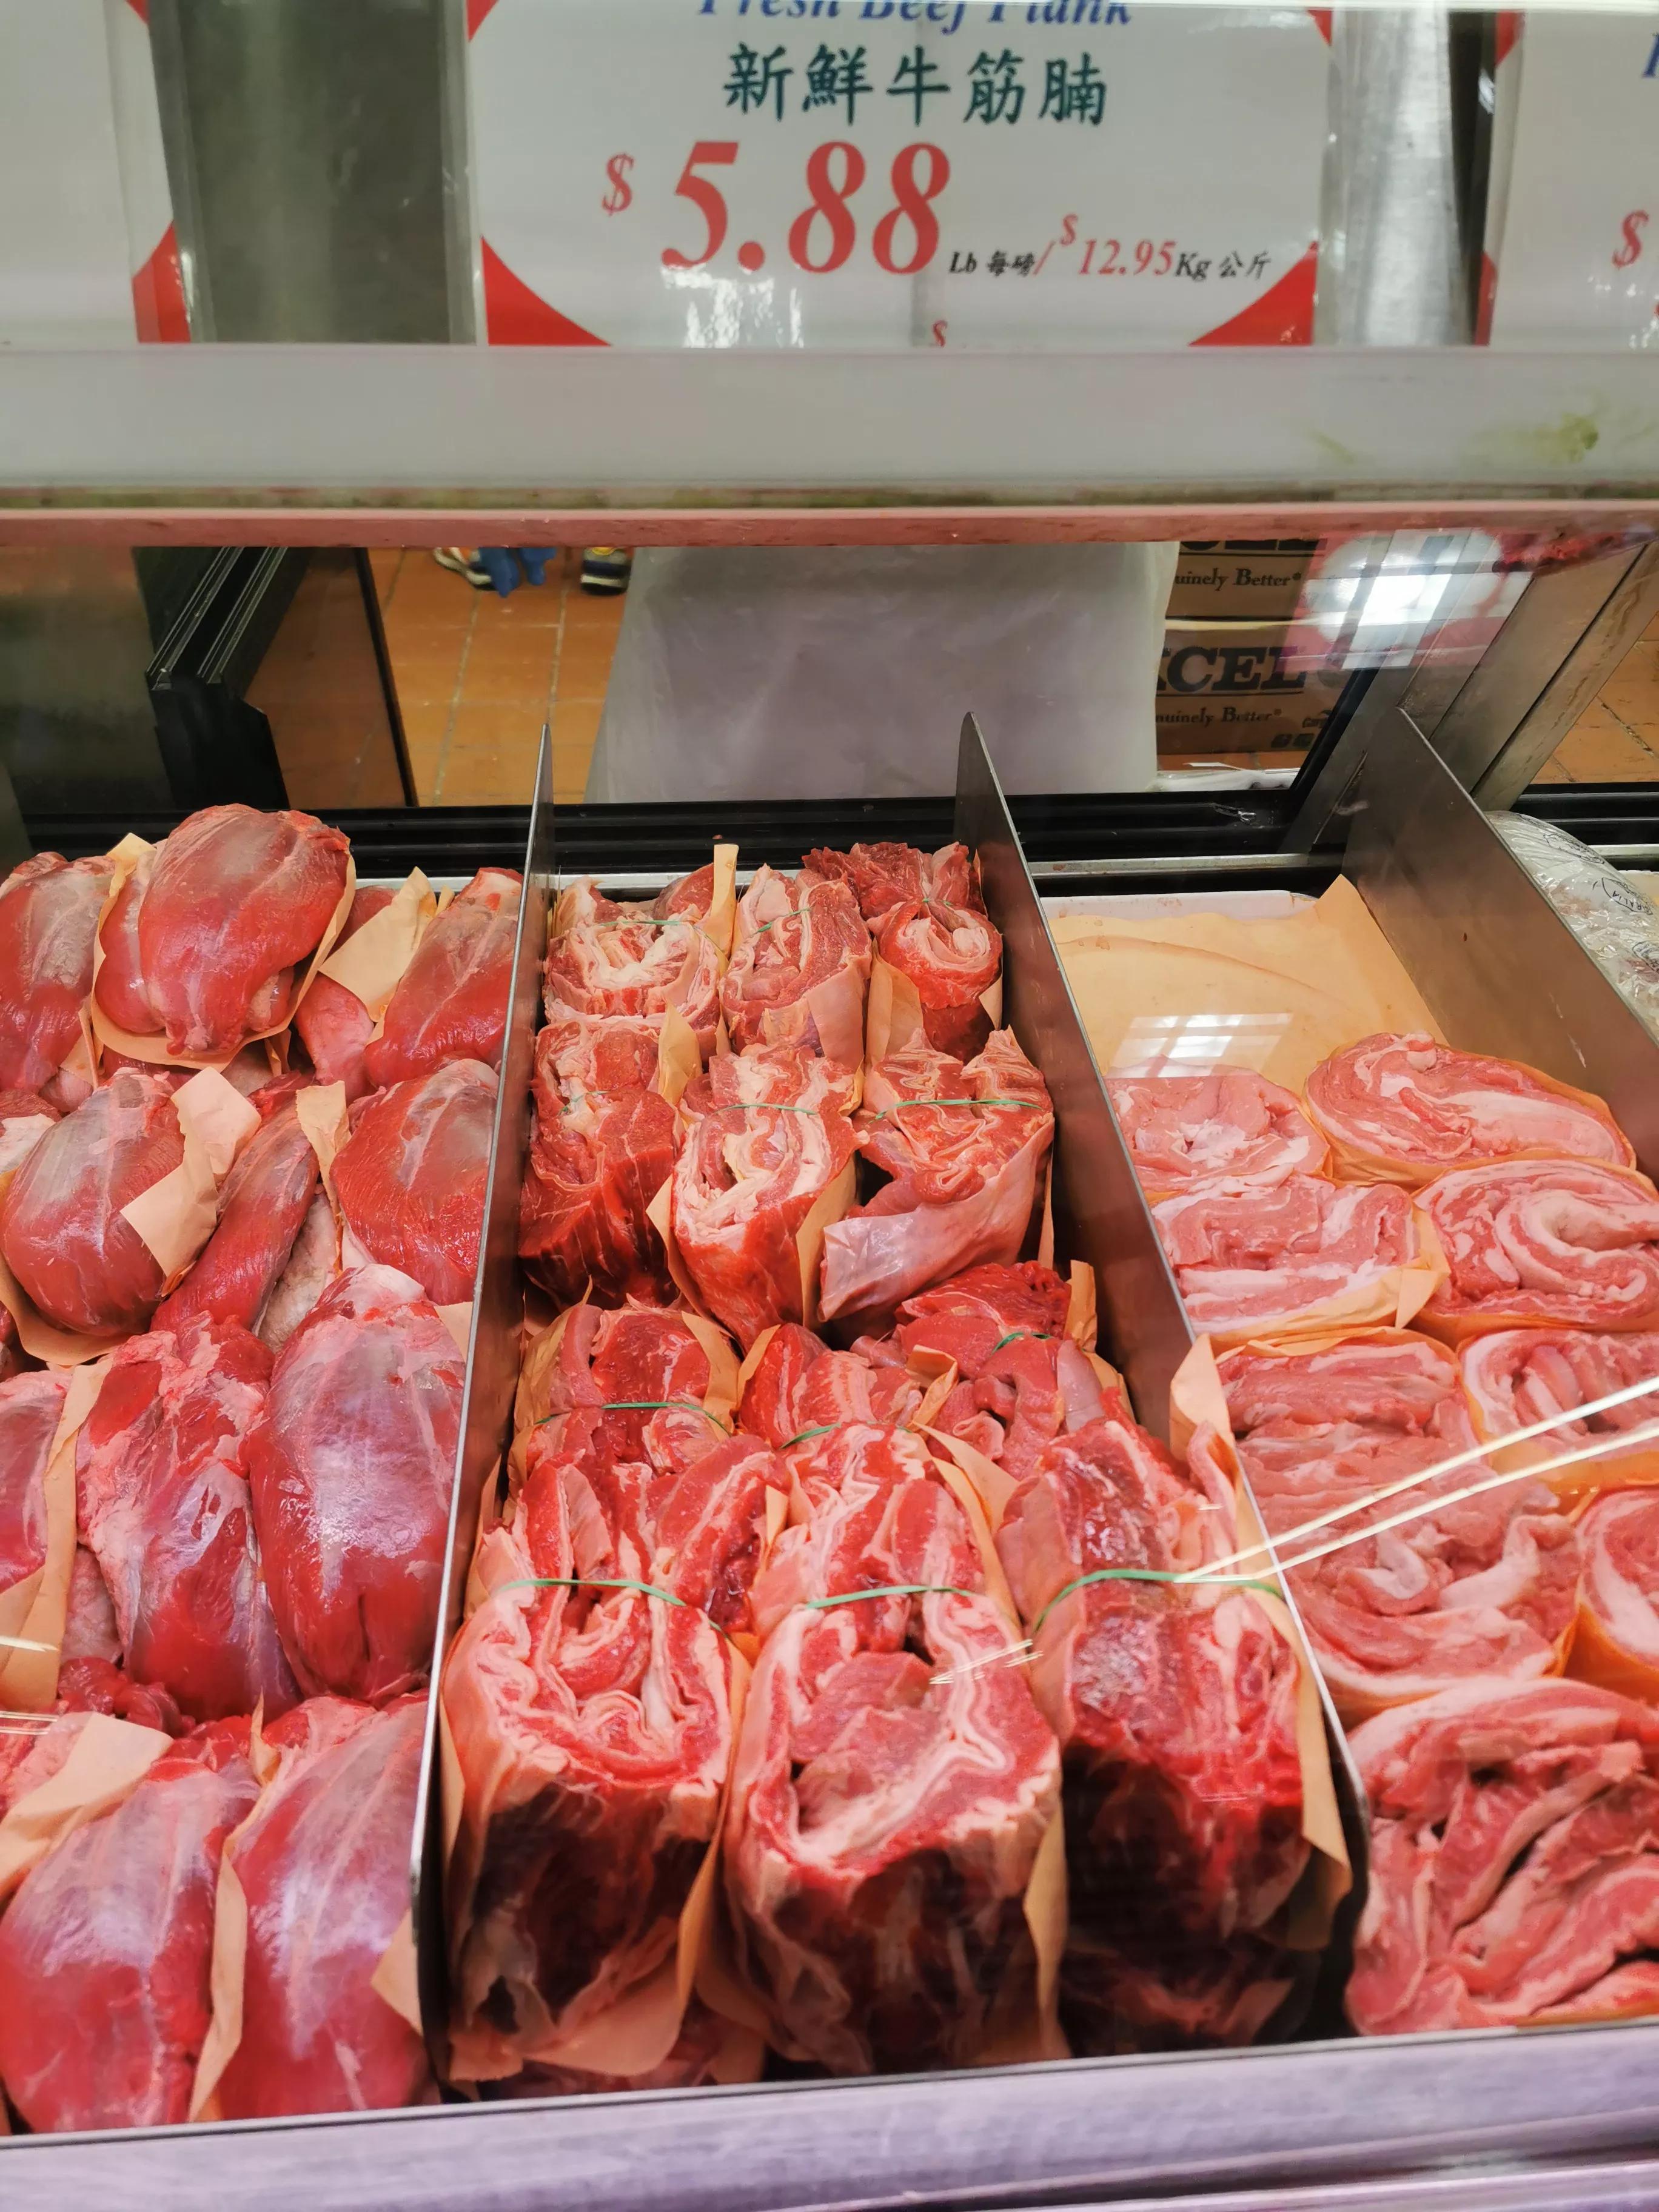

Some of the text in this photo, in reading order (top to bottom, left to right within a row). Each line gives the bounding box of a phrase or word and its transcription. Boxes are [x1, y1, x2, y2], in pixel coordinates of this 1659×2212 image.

[723, 42, 1108, 126] 新鮮牛筋腩
[660, 141, 951, 274] 5.88
